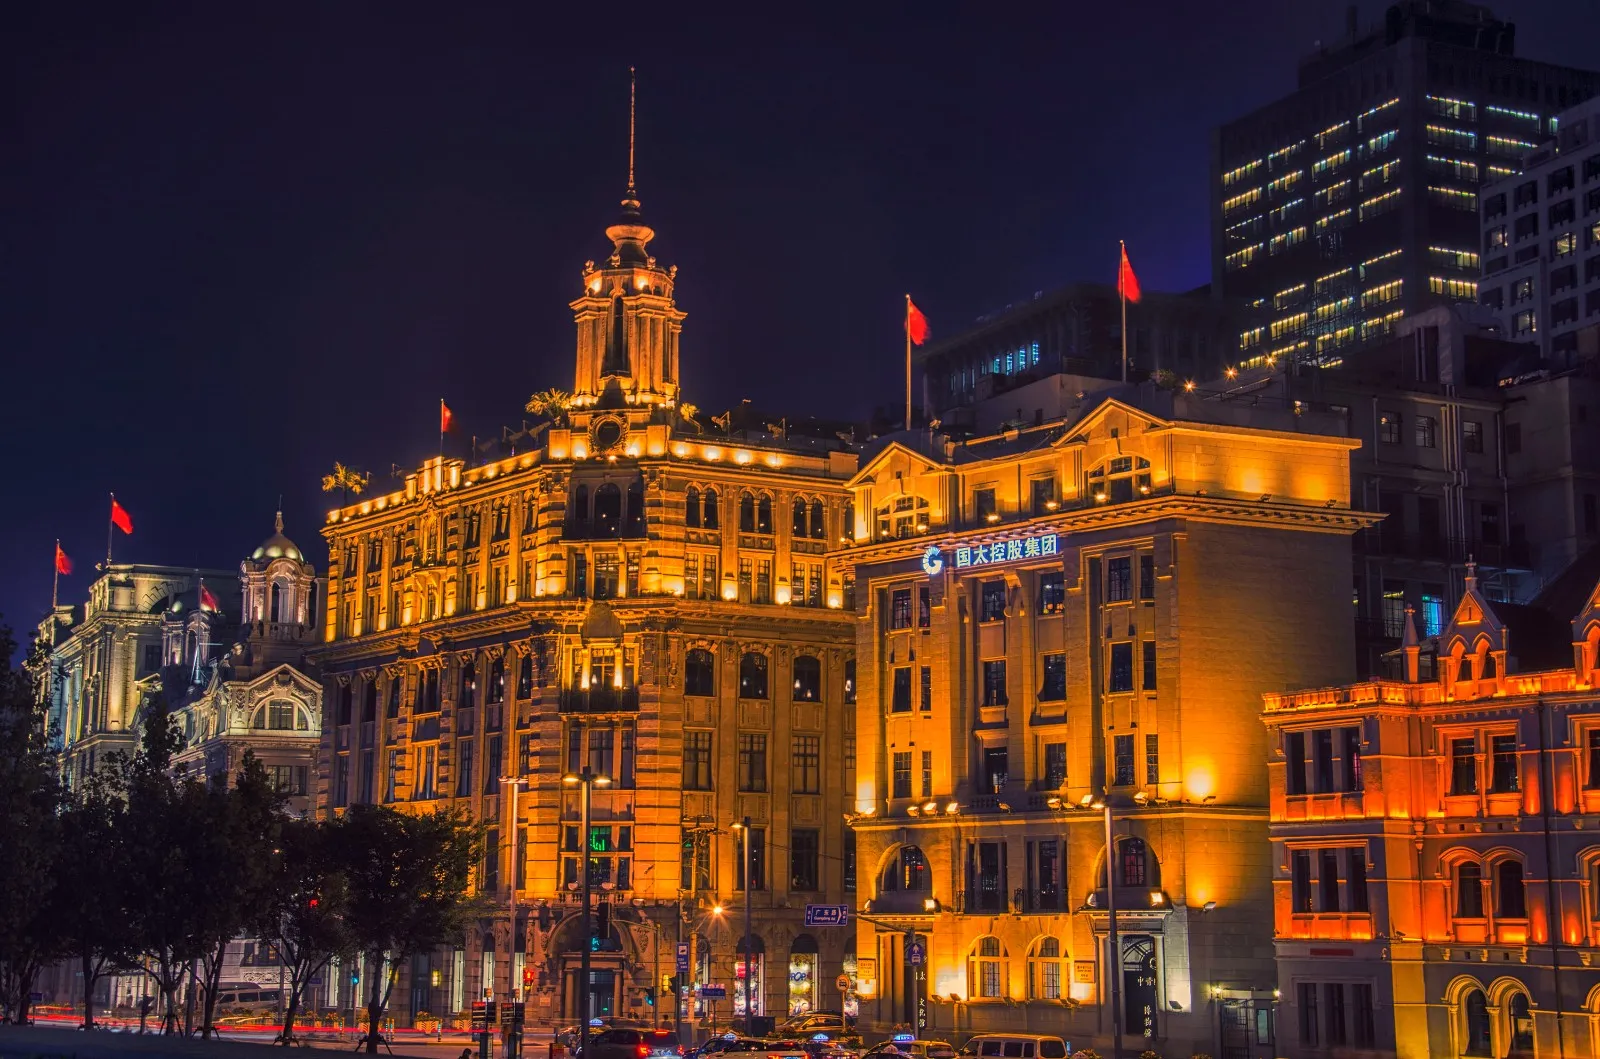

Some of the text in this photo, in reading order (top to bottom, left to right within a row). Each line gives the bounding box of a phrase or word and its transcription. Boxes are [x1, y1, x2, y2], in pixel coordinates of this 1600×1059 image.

[956, 534, 1057, 567] 国太控股集团
